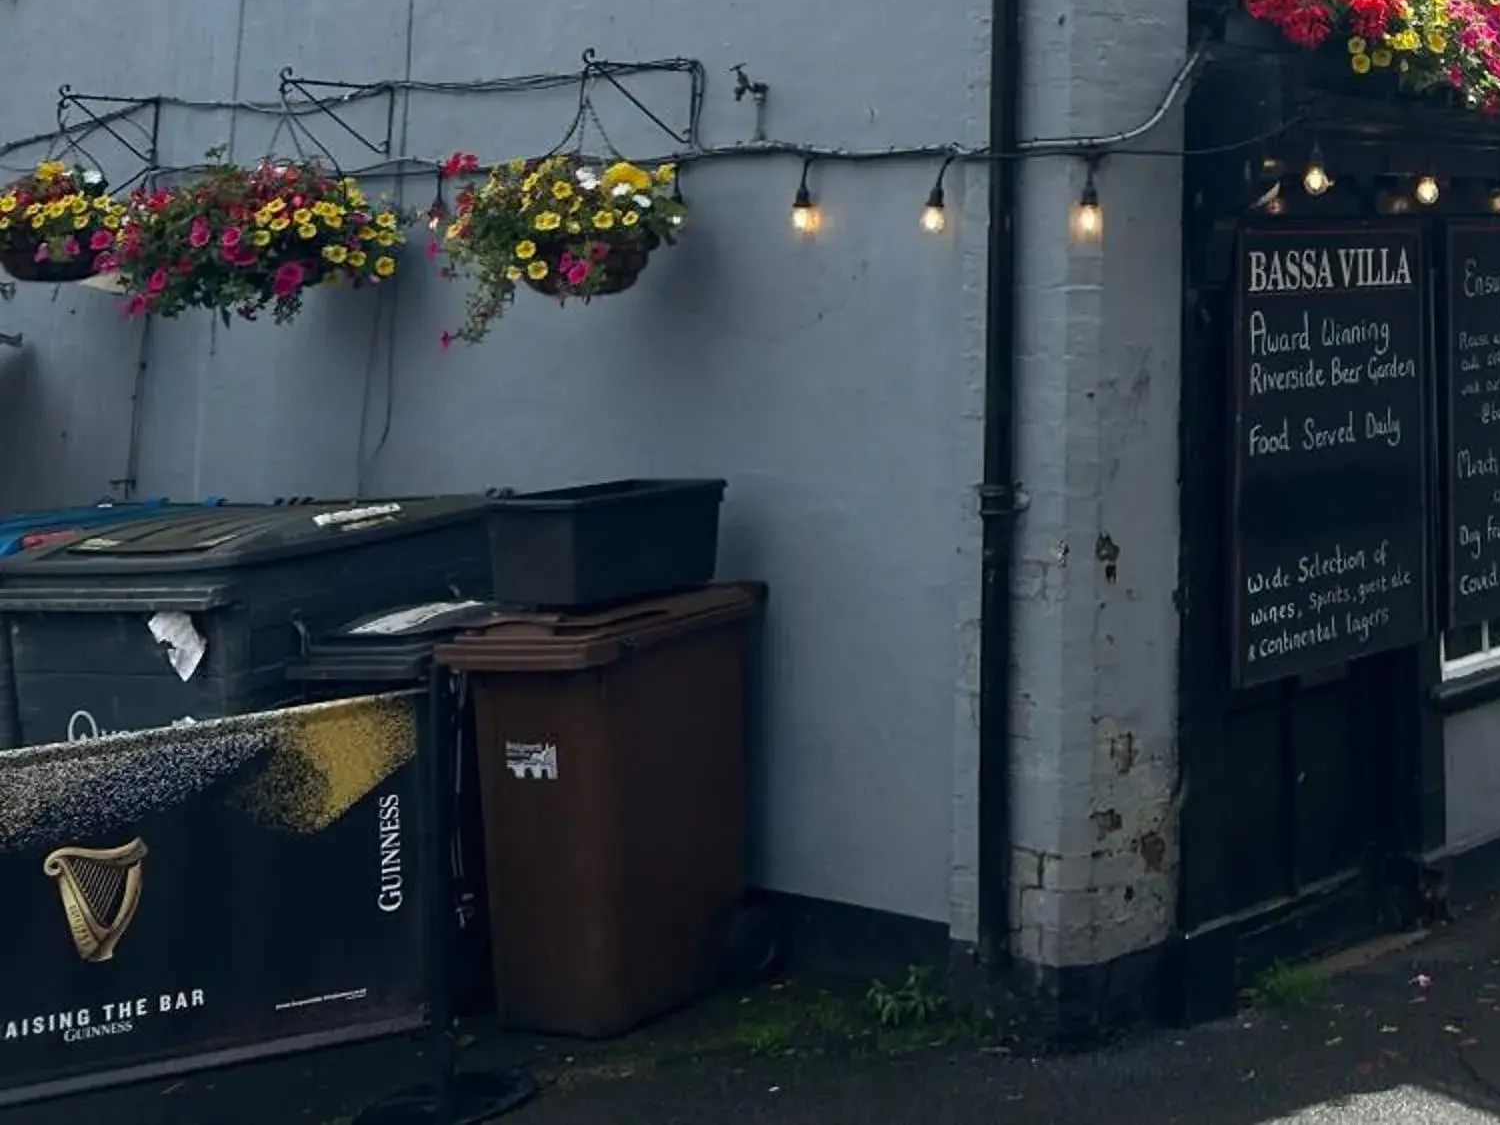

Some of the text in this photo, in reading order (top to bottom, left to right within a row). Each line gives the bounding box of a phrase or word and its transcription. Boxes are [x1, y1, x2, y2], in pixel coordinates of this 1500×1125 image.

[1248, 246, 1412, 292] BASSA VILLA
[1251, 310, 1390, 357] Award Winning
[1250, 354, 1415, 395] Riverside Beer Garden
[1249, 406, 1401, 456] Food Served Daily
[1297, 543, 1367, 583] Selection
[1373, 539, 1389, 566] of
[378, 794, 403, 912] GUINNESS
[102, 998, 148, 1021] THE
[159, 988, 204, 1012] BAR
[63, 1021, 133, 1042] GUINNESS
